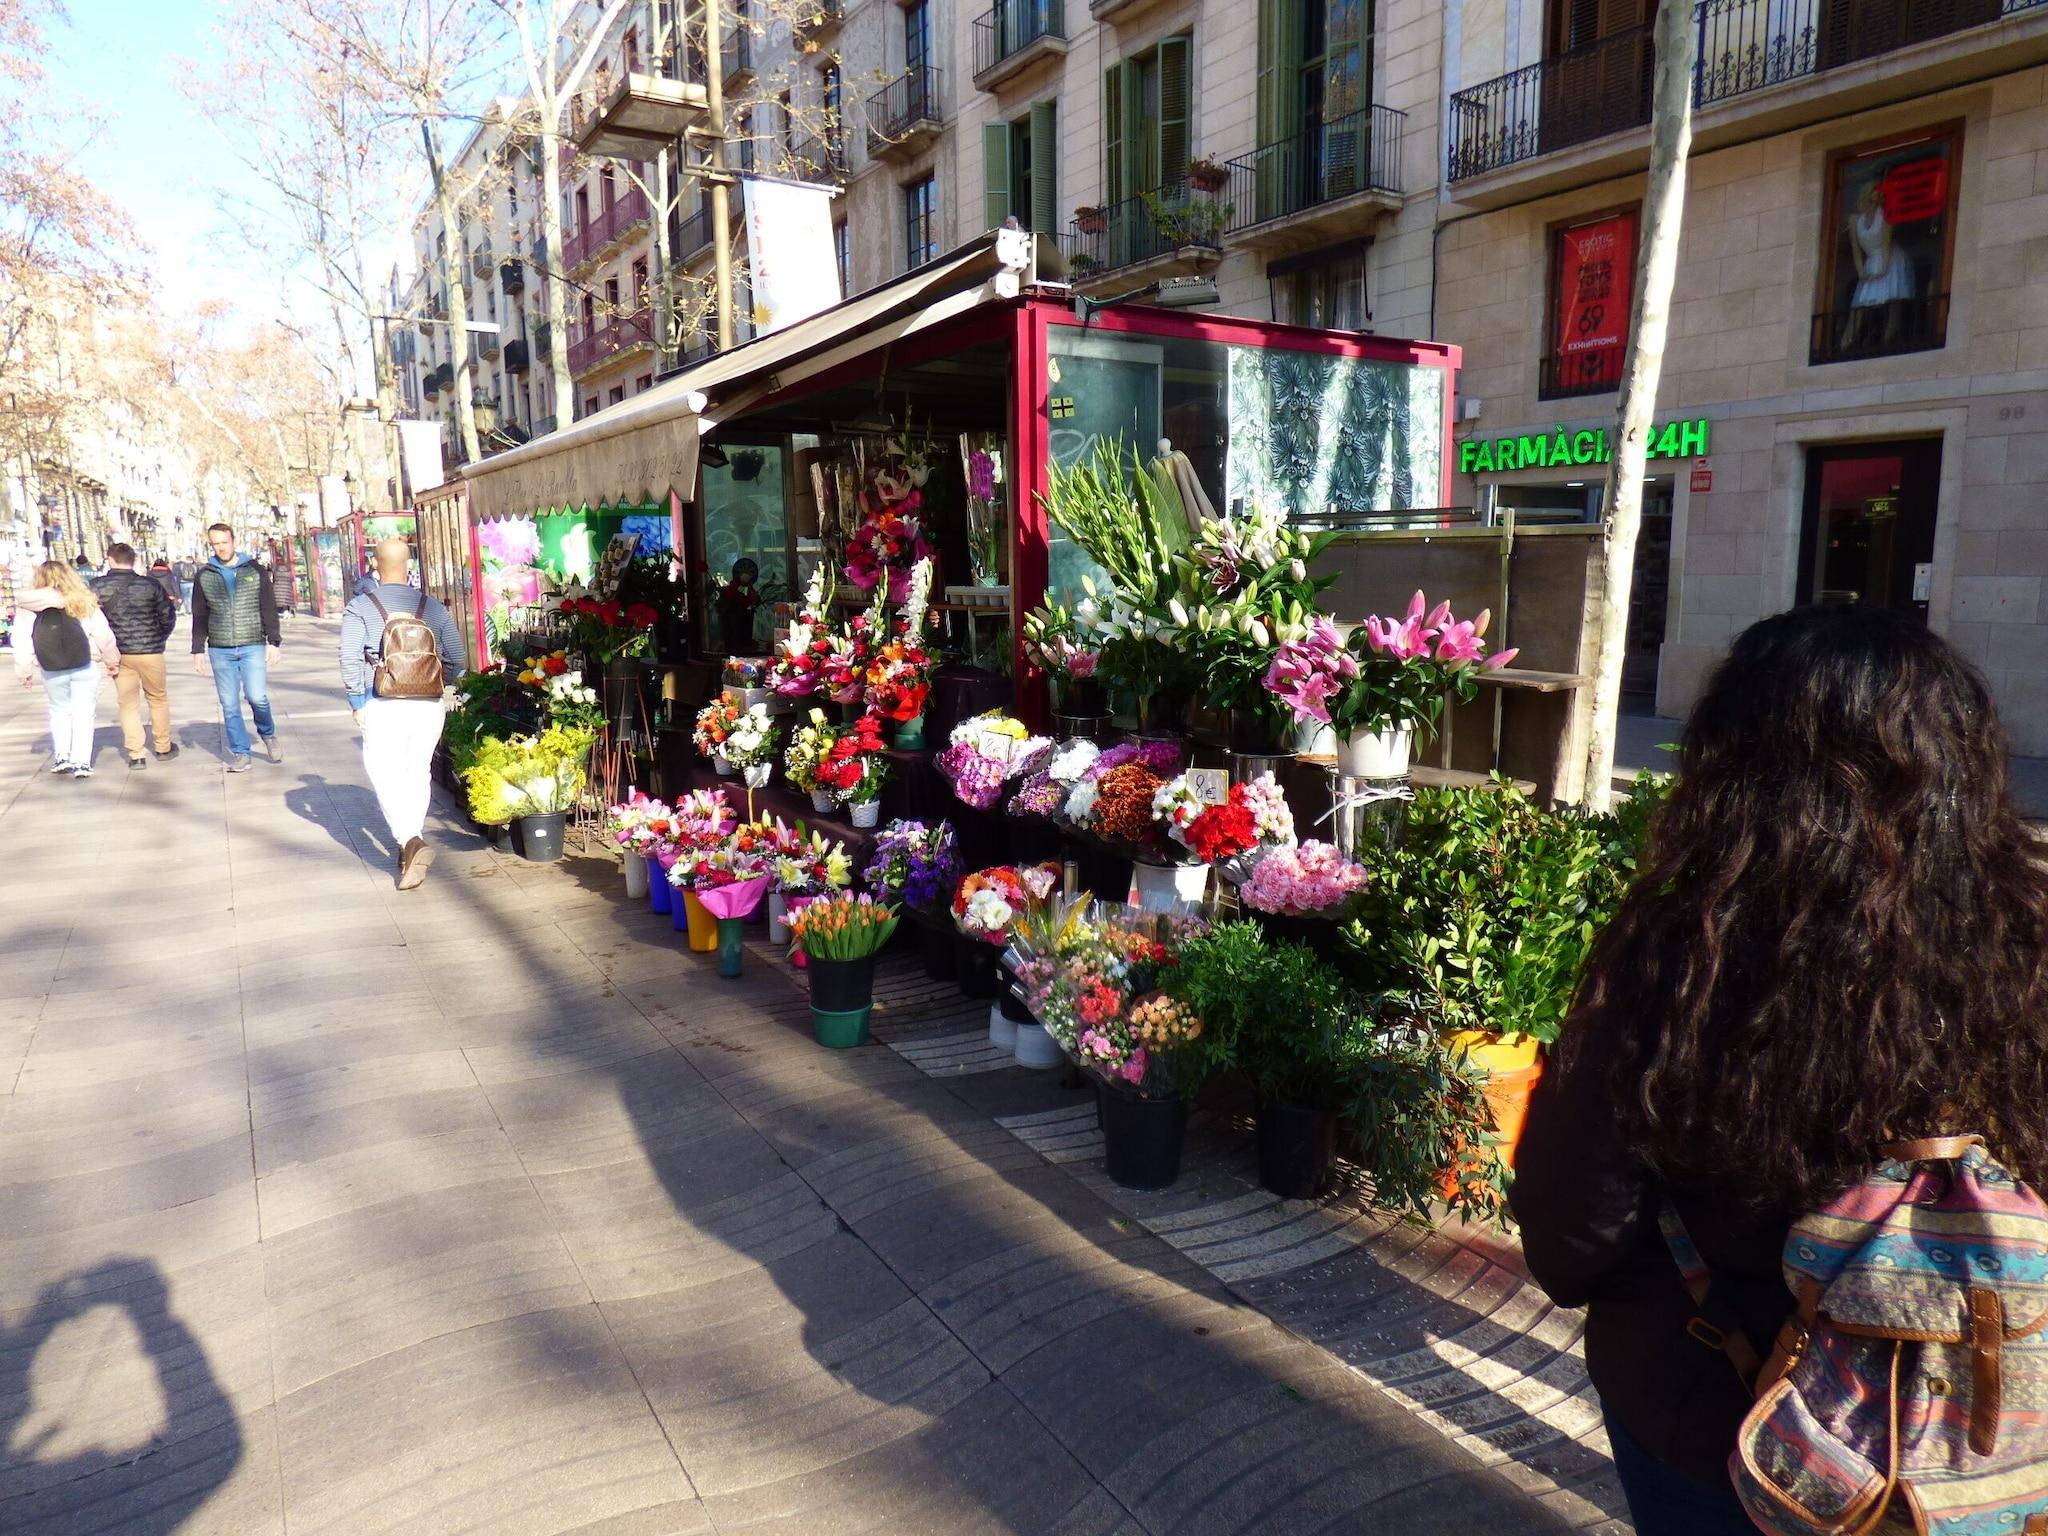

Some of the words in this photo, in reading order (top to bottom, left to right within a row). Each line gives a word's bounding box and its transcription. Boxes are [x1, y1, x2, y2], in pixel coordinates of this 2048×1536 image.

[1578, 233, 1615, 249] EROTIC
[1578, 304, 1605, 335] 69
[1460, 423, 1612, 473] FARMÀCI
